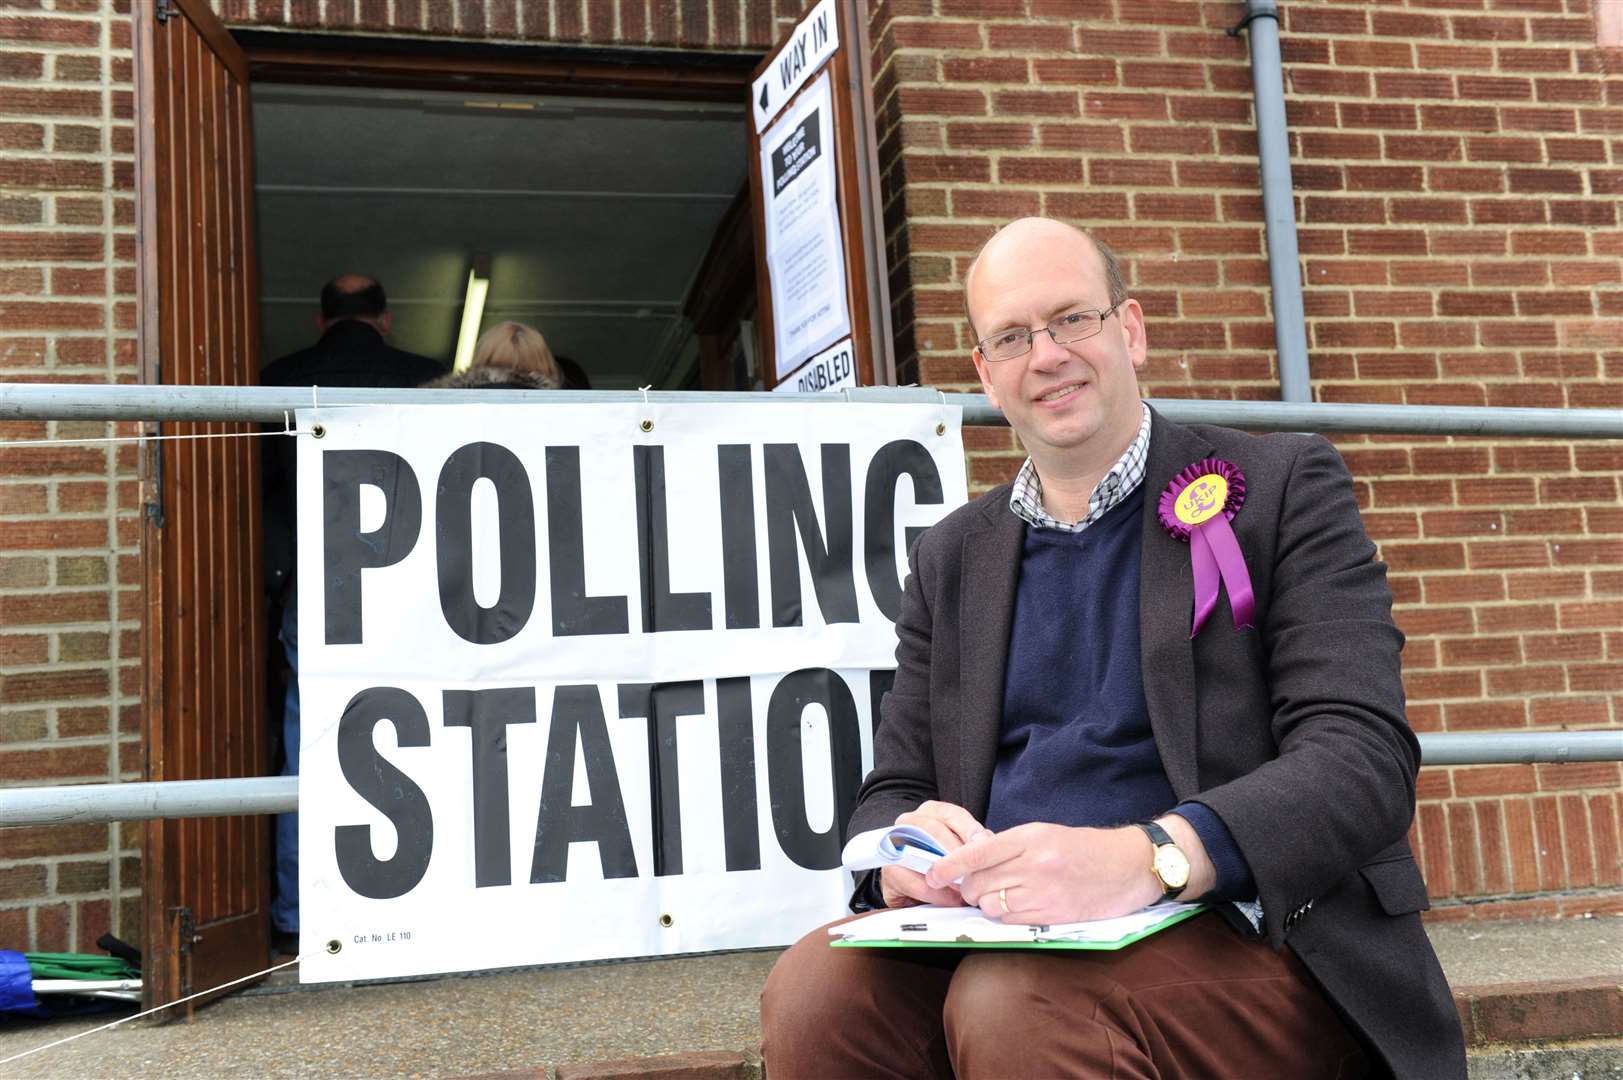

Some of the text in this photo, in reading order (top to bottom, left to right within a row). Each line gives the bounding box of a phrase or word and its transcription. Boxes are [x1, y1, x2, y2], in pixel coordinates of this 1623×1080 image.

[780, 10, 828, 91] WAY IN
[1183, 484, 1217, 510] UKIP
[322, 439, 945, 646] POLLING
[334, 667, 899, 900] STATIO
[386, 932, 396, 942] LE
[399, 931, 411, 941] 110
